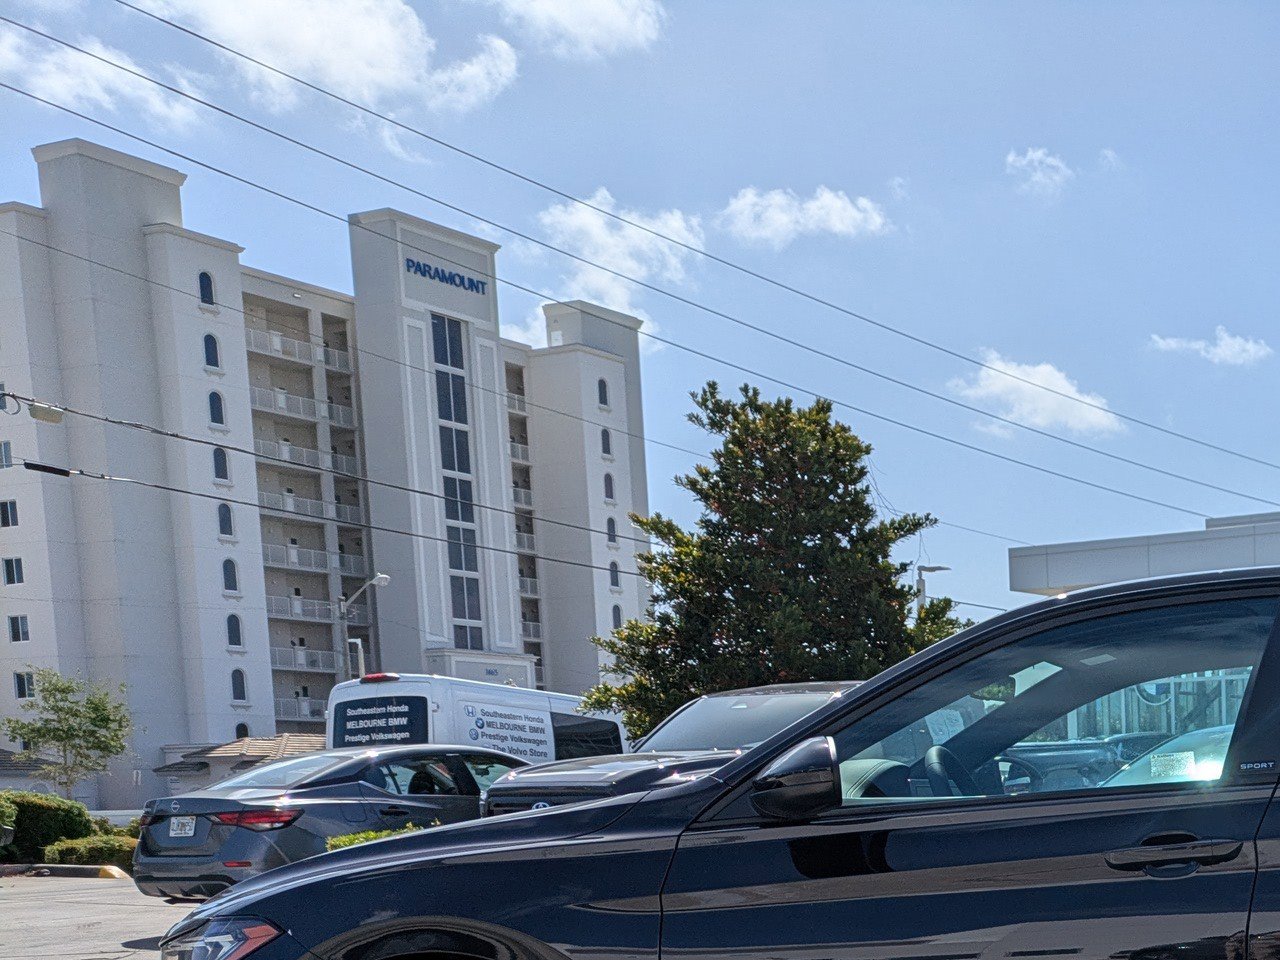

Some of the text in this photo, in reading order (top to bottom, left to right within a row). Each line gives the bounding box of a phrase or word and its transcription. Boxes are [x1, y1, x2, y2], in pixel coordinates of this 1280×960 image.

[405, 257, 488, 295] PARAMOUNT
[346, 704, 409, 716] Southeastern Honda
[480, 708, 544, 724] Southeastern Honda
[346, 716, 409, 730] MELBOURNE BMW
[485, 720, 546, 735] MELBOURNE BMW
[344, 732, 410, 743] Prestige Volkswagen
[480, 731, 548, 746] Prestige Volkswagen
[492, 744, 548, 758] The Volvo Store
[1240, 762, 1275, 770] SPORT
